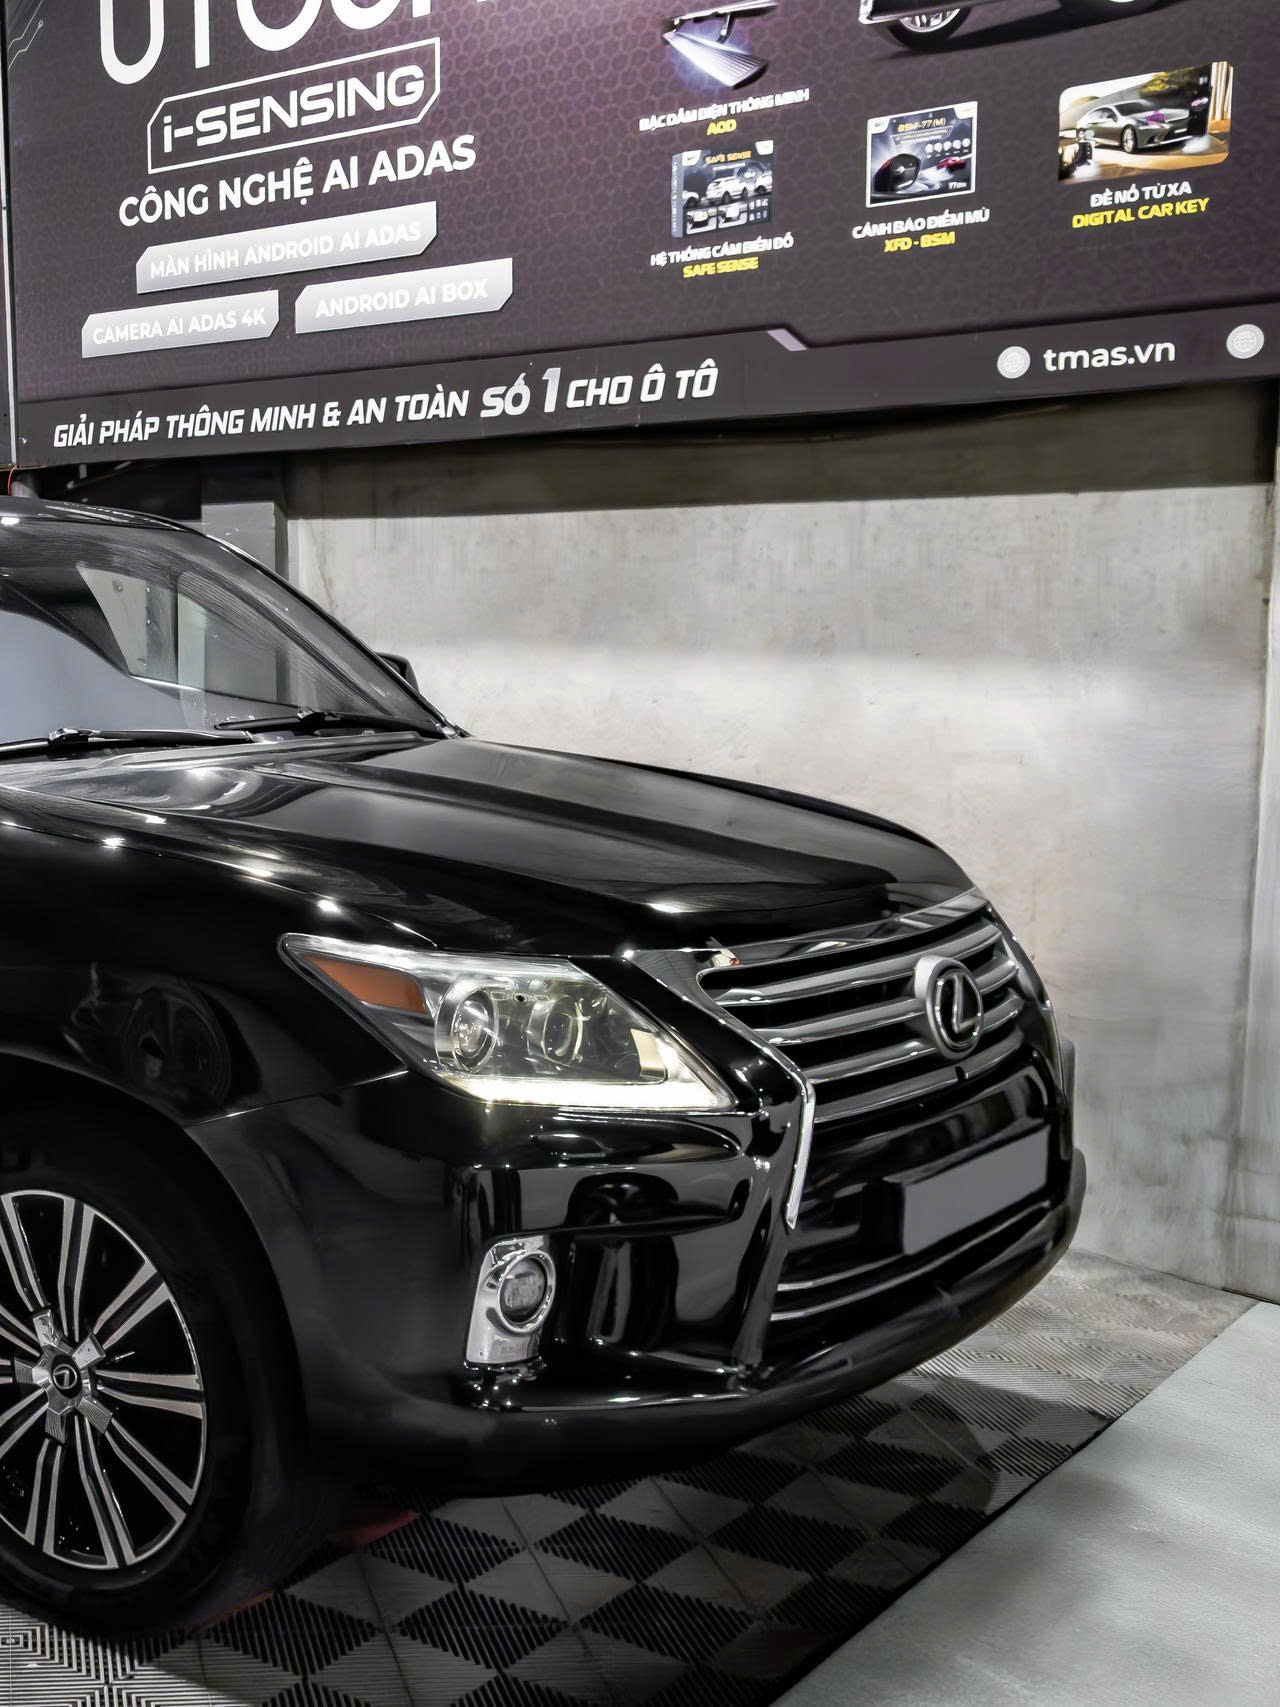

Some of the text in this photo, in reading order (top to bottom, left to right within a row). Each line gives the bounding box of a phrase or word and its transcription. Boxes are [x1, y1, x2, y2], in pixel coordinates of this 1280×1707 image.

[162, 64, 424, 153] i-SENSING
[119, 134, 477, 227] CÔNG NGHỆ AI ADAS
[1167, 181, 1192, 197] XA
[1071, 197, 1210, 228] DIGITAL CAR KEY
[149, 221, 422, 280] MÀN HÌNH ANDROID AI ADAS
[920, 231, 955, 248] BSM
[683, 256, 759, 278] SAFE SENSE
[315, 278, 488, 319] ANDROID AI BOX
[93, 307, 266, 345] CAMERA AI ADAS 4K
[1043, 342, 1175, 371] tmas.vn
[53, 358, 719, 448] GIẢI PHÁP THÔNG MINH & AN TOÀN SỐ 1 CHO Ô TÔ
